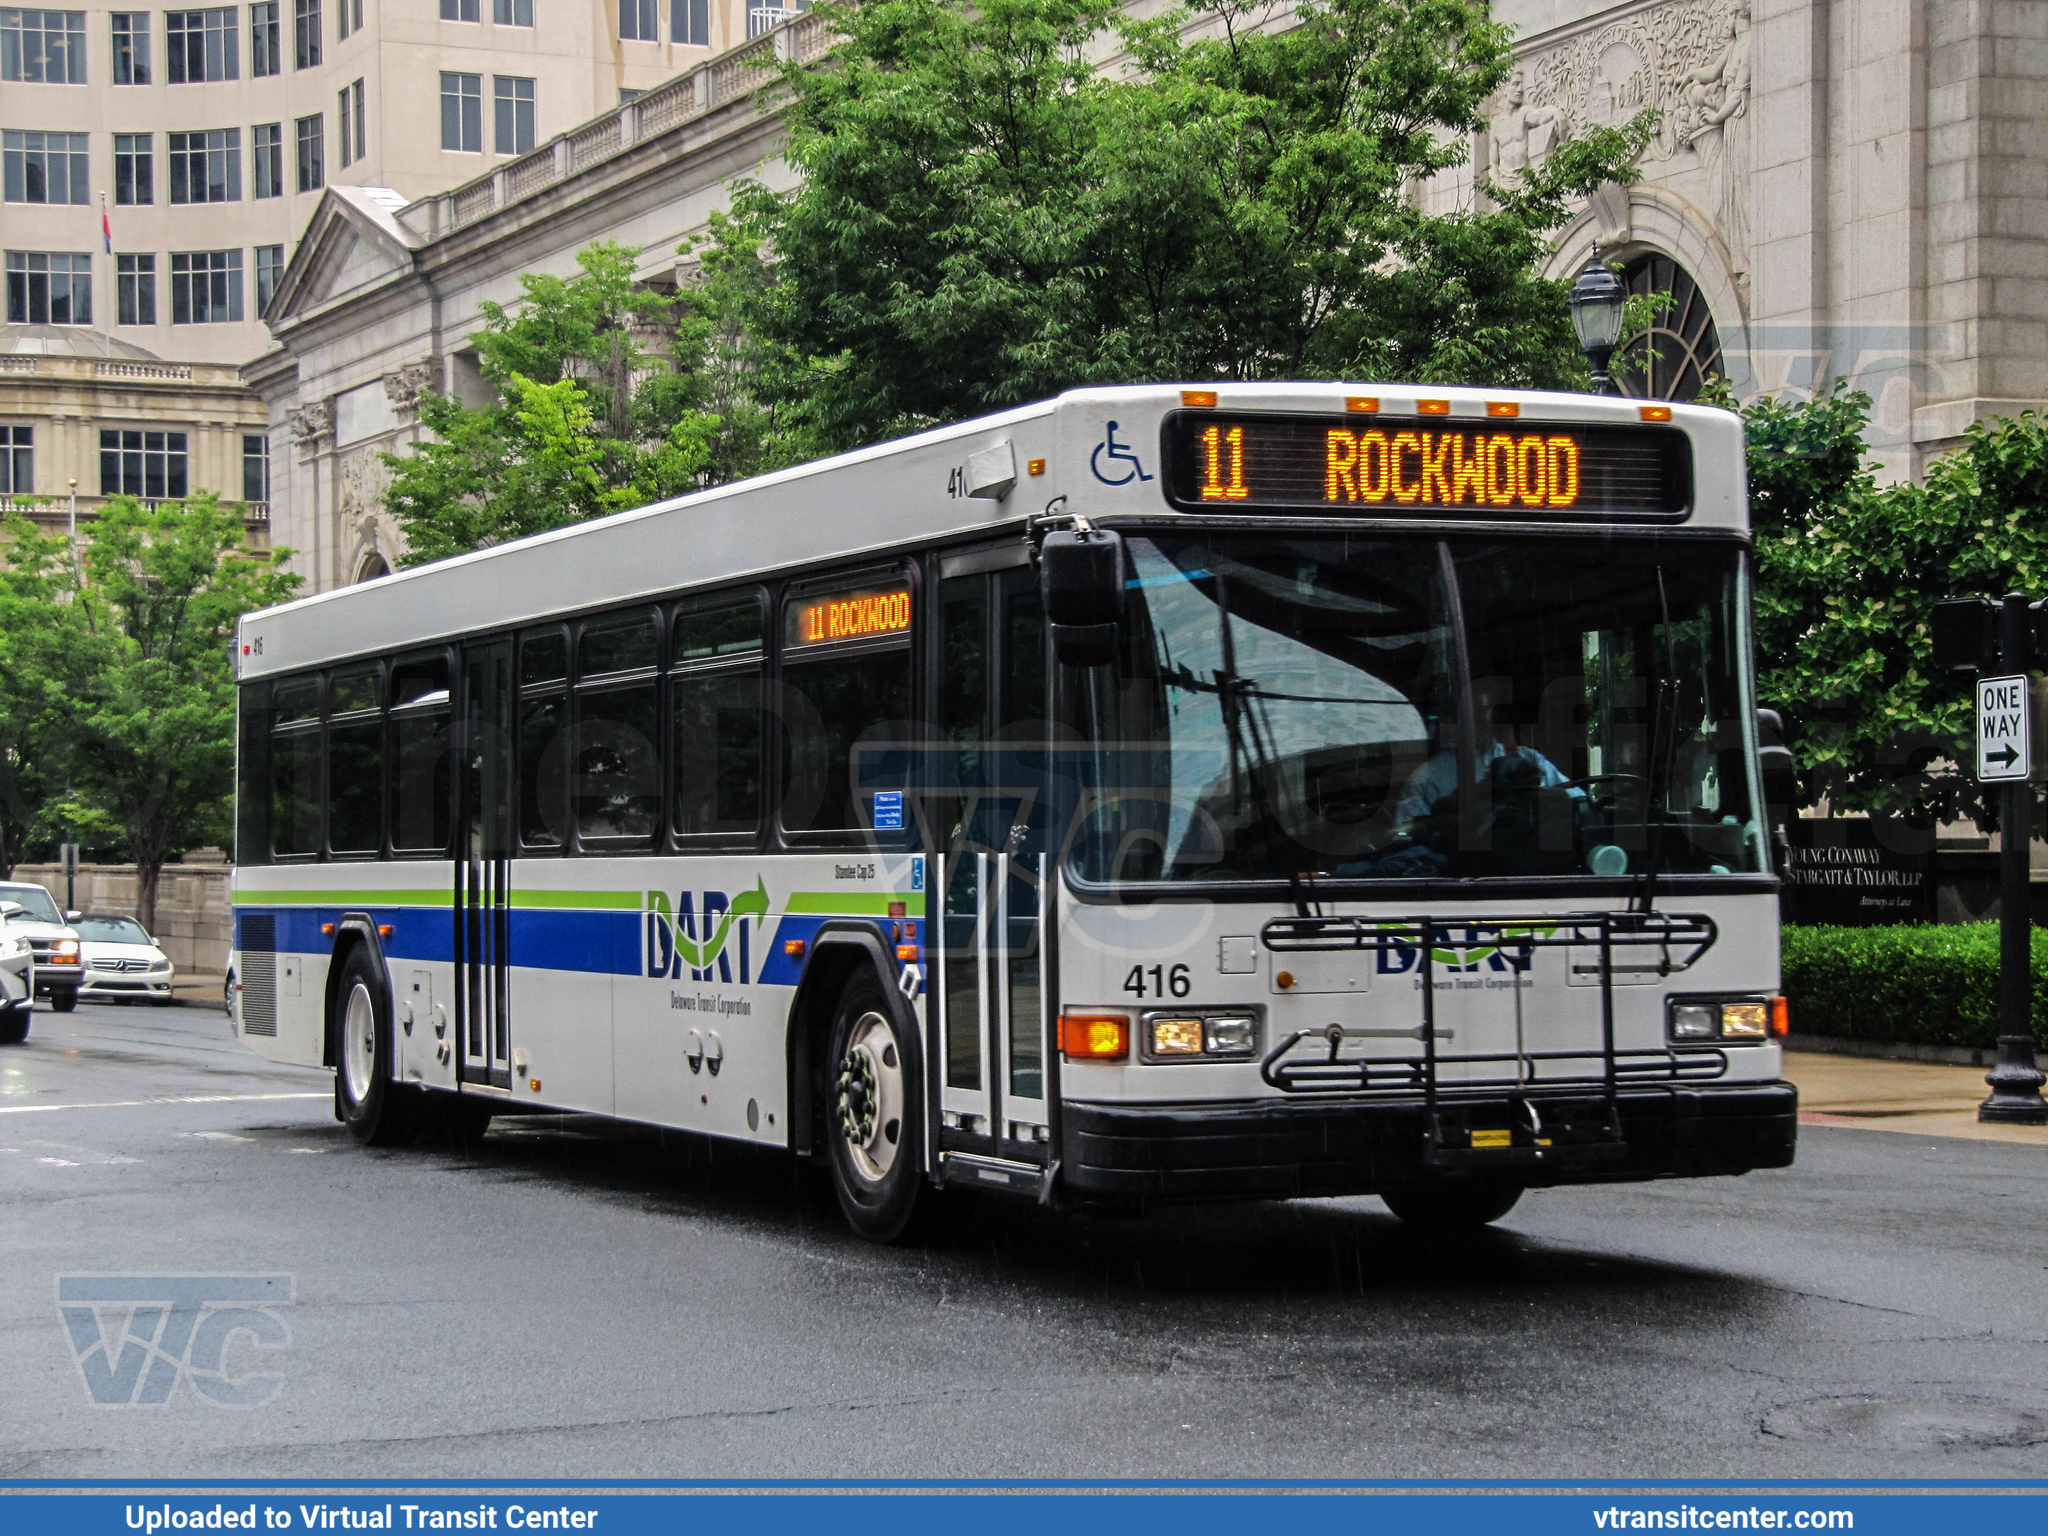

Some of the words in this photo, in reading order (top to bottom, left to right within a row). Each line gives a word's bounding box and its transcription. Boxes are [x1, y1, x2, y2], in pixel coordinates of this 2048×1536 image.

[1201, 426, 1248, 500] 11
[1325, 429, 1579, 507] ROCKWOOD
[948, 467, 968, 499] 41
[807, 606, 824, 640] 11
[829, 592, 911, 637] ROCKWOOD
[253, 636, 264, 656] 416
[1984, 685, 2020, 711] ONE
[1983, 713, 2021, 739] WAY
[1828, 846, 1881, 864] CONAWAY
[868, 863, 875, 879] 25
[1789, 869, 1844, 885] STARGATT
[1844, 868, 1853, 886] &
[1902, 872, 1923, 886] LLP
[1896, 896, 1912, 907] Law
[648, 888, 768, 985] DART
[1377, 922, 1556, 974] DART
[1123, 963, 1192, 999] 416
[1414, 979, 1453, 990] Deware
[1455, 978, 1483, 989] Transit
[671, 990, 696, 1011] Delaware
[697, 992, 716, 1013] Transit
[717, 994, 752, 1019] Corporation
